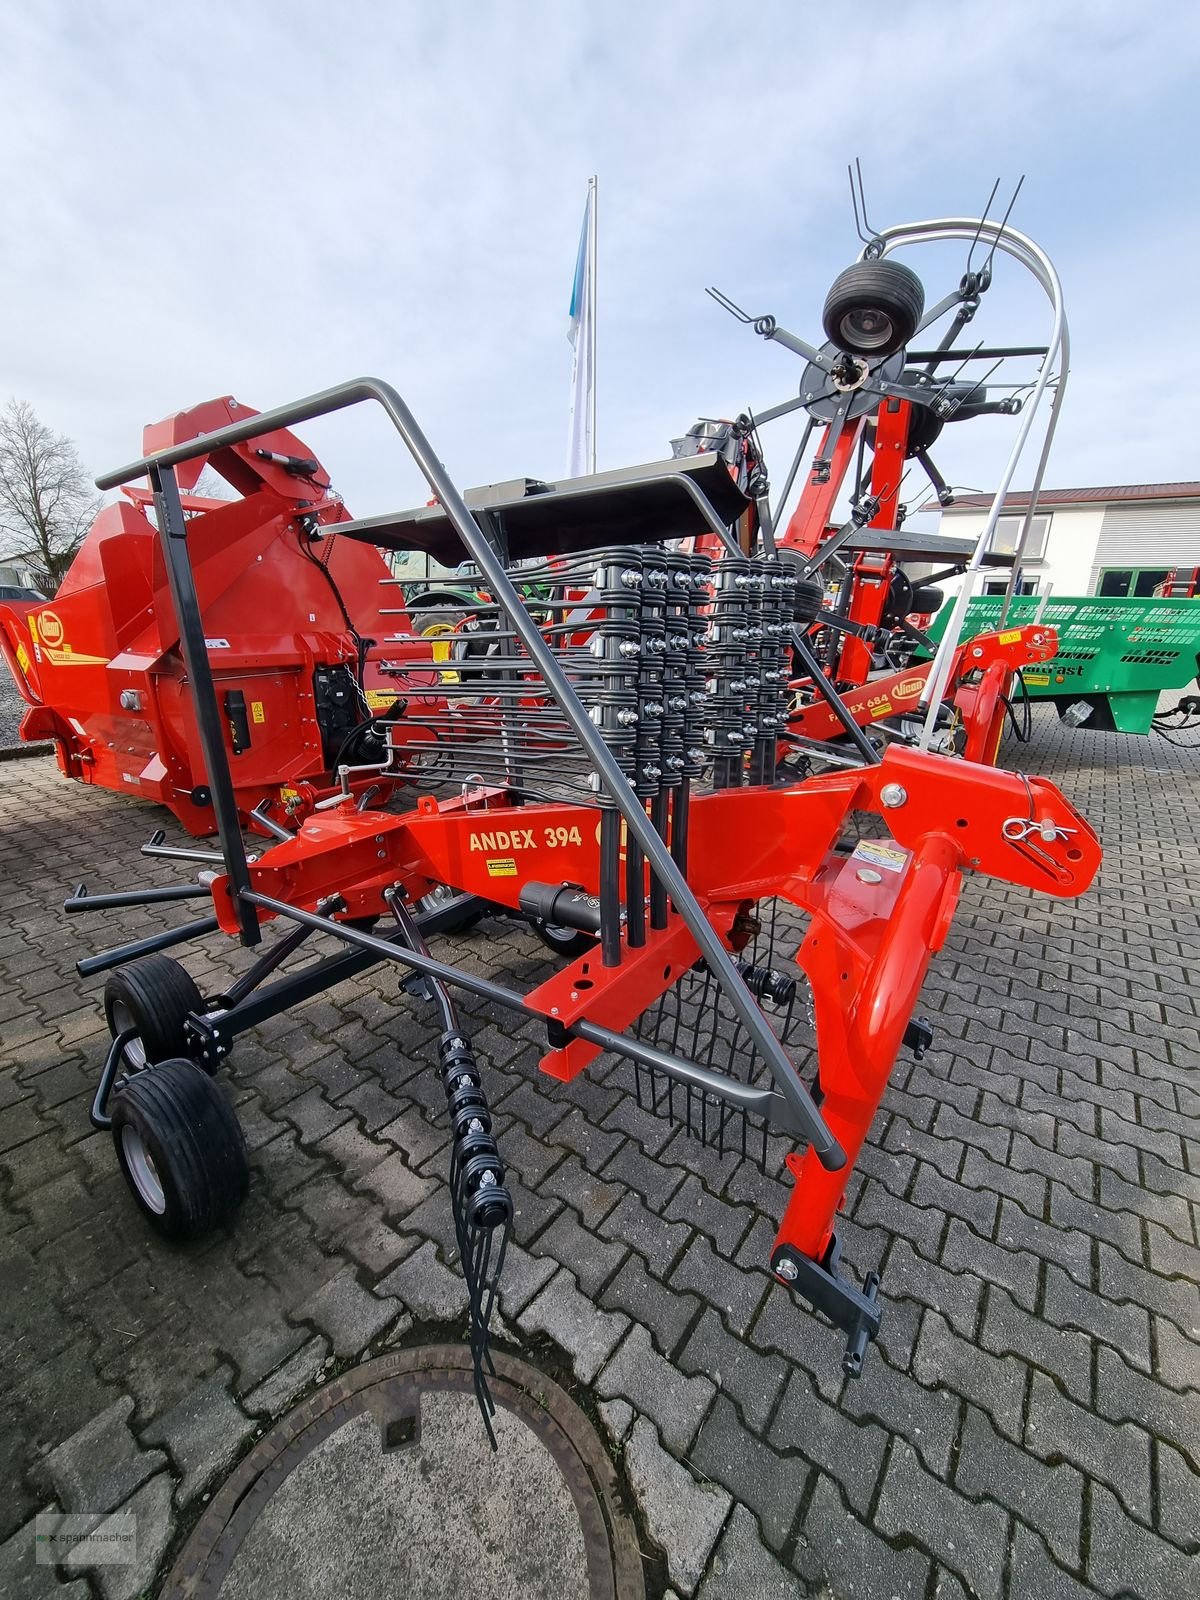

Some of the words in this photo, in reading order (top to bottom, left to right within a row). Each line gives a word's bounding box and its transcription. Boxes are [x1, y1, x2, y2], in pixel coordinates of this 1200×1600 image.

[895, 679, 923, 697] Vicon
[867, 694, 889, 707] 684
[470, 829, 537, 851] ANDEX
[544, 826, 582, 848] 394
